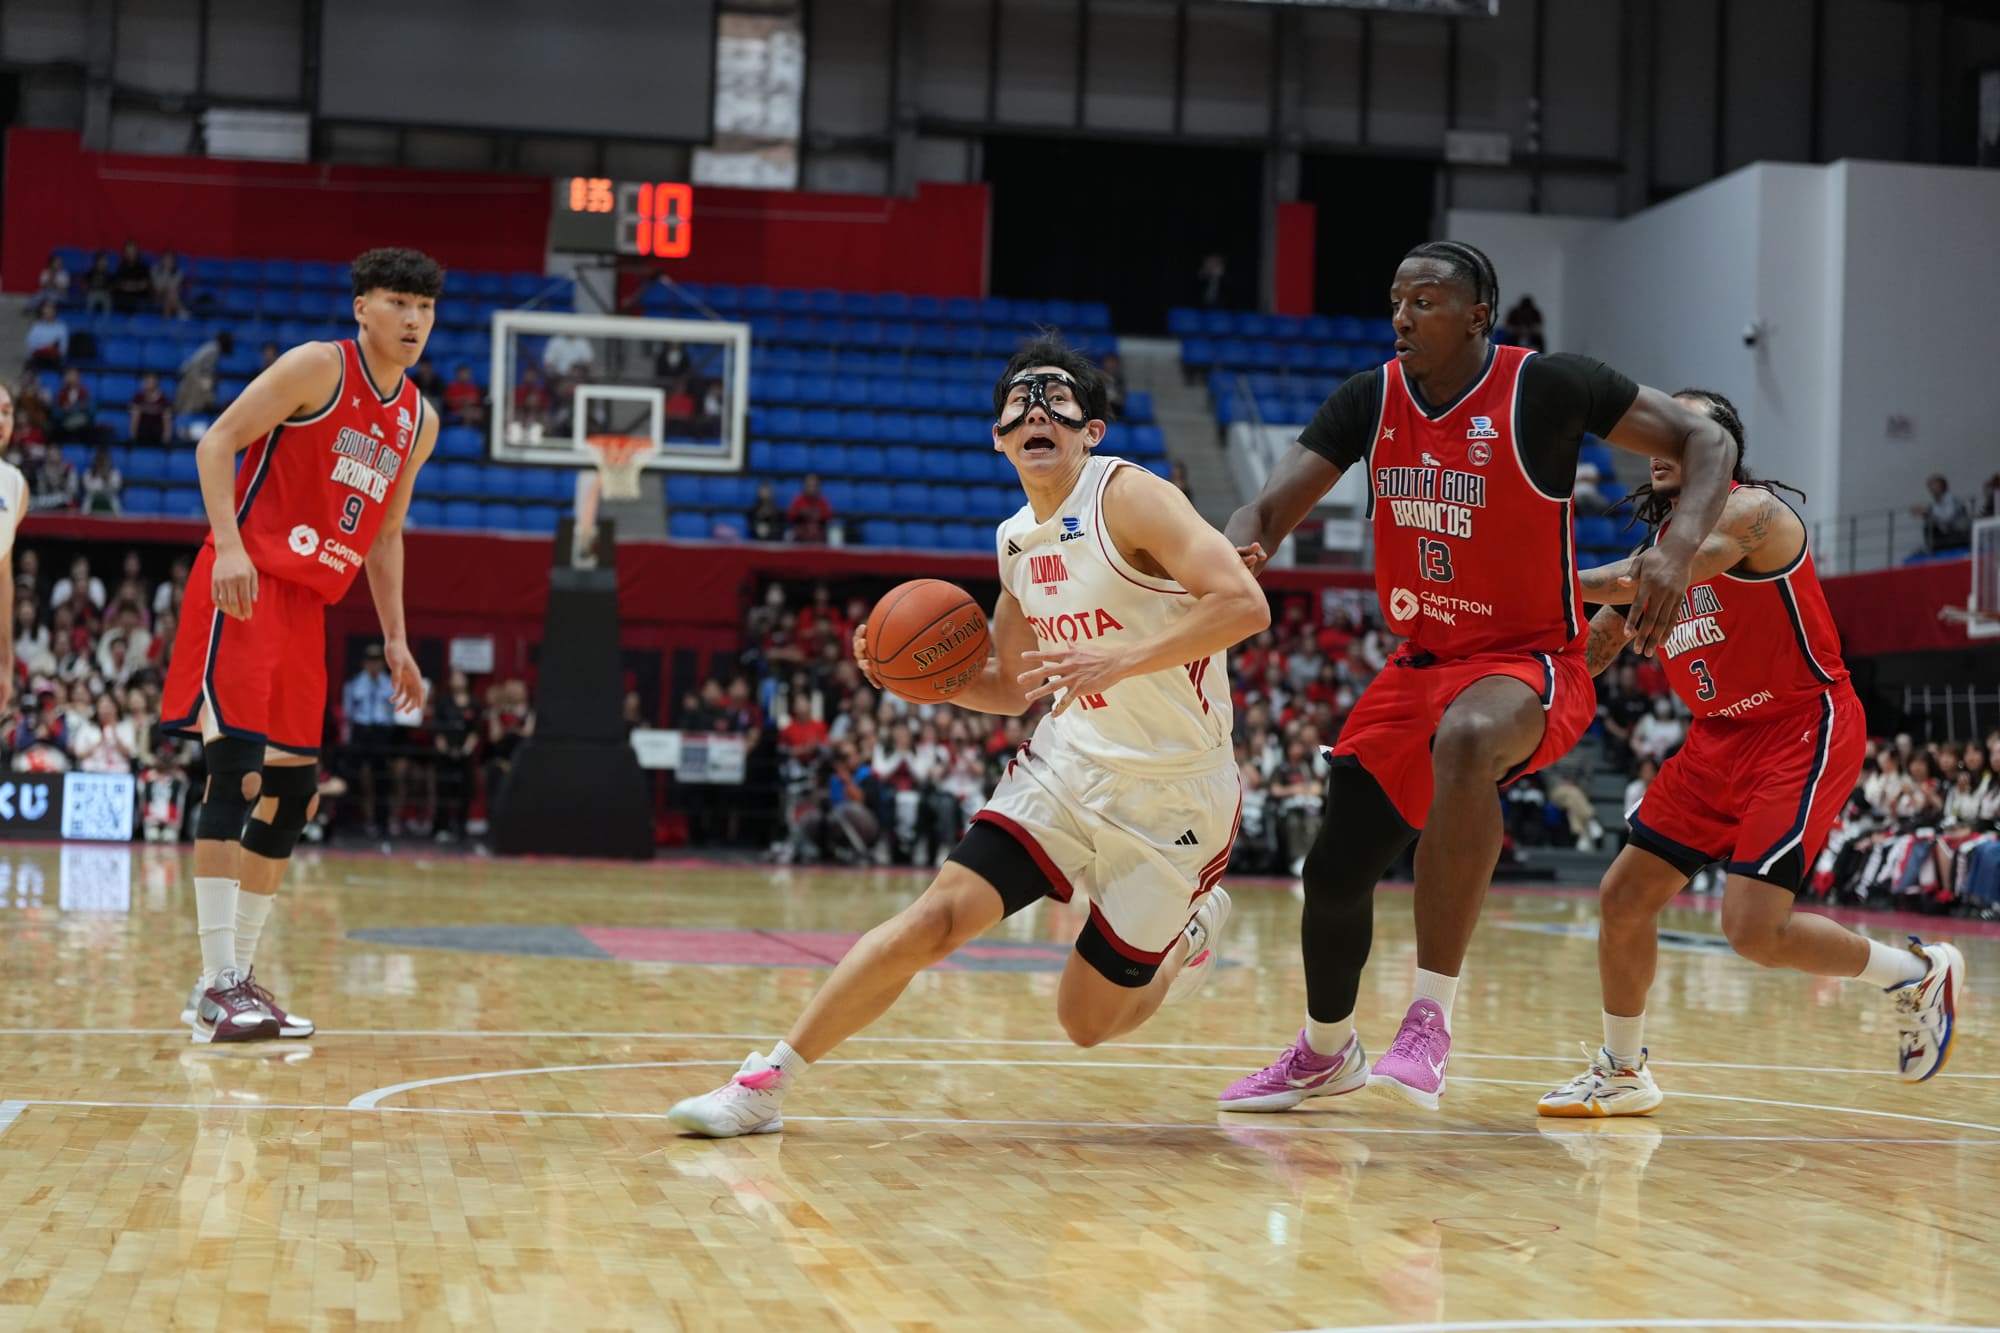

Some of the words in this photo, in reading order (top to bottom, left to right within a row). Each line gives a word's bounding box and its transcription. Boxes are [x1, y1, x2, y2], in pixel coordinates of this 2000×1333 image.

[637, 181, 693, 259] 10
[331, 427, 379, 467] SOUTH
[1468, 429, 1498, 438] EASL
[330, 456, 389, 504] BRONCOS
[1377, 467, 1437, 500] SOUTH
[1441, 469, 1486, 508] GOBI
[339, 494, 364, 534] 9
[1391, 500, 1472, 538] BRONCOS
[324, 538, 363, 568] CAPITRO
[1060, 532, 1085, 542] EASL
[319, 551, 347, 574] BANK
[1030, 555, 1068, 584] ALVARK
[1418, 537, 1454, 583] 13
[1044, 586, 1058, 595] TOKYO
[1420, 591, 1492, 616] CAPITRON
[1692, 585, 1724, 617] GOBI
[1423, 603, 1456, 626] BANK
[912, 611, 984, 671] SPALDING
[1689, 659, 1716, 701] 3
